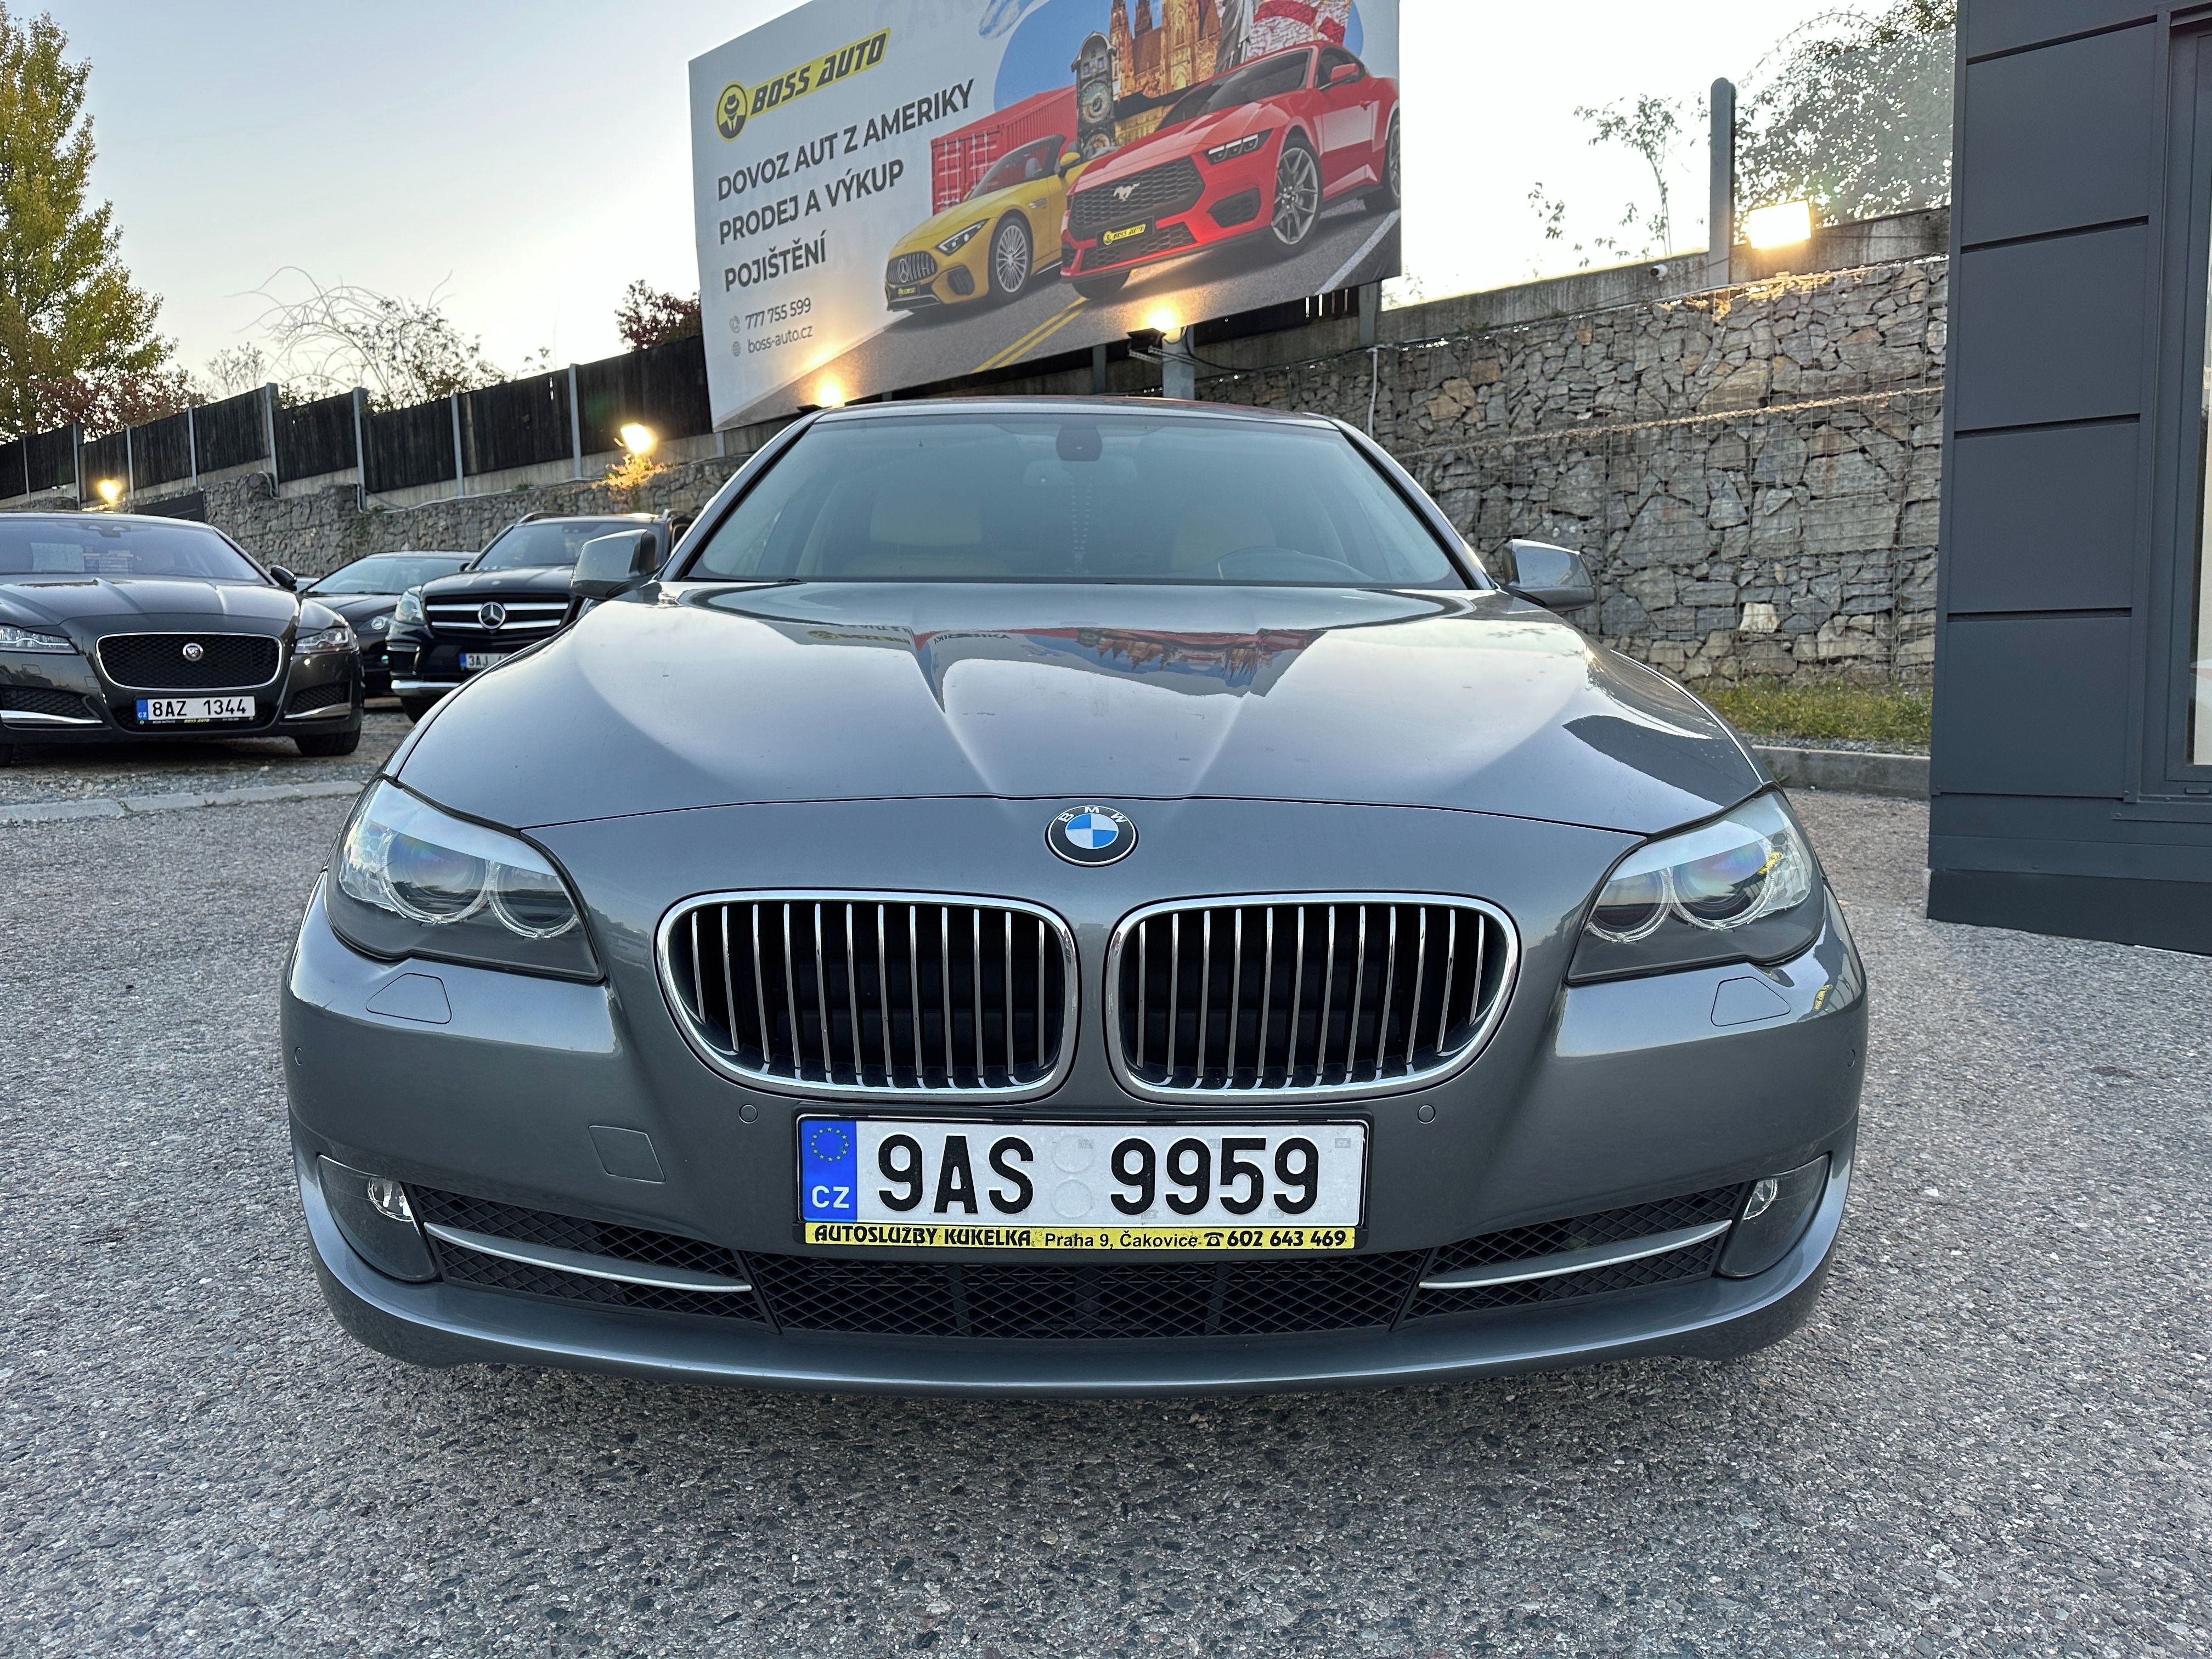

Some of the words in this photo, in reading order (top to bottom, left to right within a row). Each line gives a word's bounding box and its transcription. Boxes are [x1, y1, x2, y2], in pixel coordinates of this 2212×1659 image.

[751, 65, 811, 116] BOSS
[815, 32, 887, 88] AUTO
[718, 151, 789, 201] DOVOZ
[794, 132, 839, 173] AUT
[843, 125, 858, 154] Z
[863, 78, 975, 148] AMERIKY
[719, 195, 799, 245] PRODEJ
[804, 189, 821, 217] A
[825, 159, 905, 208] VÝKUP
[725, 229, 827, 292] POJIŠTĚNÍ
[745, 311, 765, 330] 777
[767, 304, 788, 323] 755
[790, 297, 811, 317] 599
[747, 326, 813, 353] boss-auto.cz
[153, 701, 187, 717] 8AZ
[203, 699, 246, 715] 1344
[1058, 806, 1127, 823] BMW
[811, 1186, 850, 1209] CZ
[878, 1133, 1034, 1215] 9AS
[1110, 1137, 1319, 1215] 9959
[815, 1226, 938, 1245] AUTOSLUŽBY
[944, 1229, 1031, 1246] KUKELKA
[1045, 1233, 1094, 1246] Praha
[1120, 1230, 1199, 1248] Čakovice
[1227, 1231, 1263, 1247] 602
[1269, 1231, 1304, 1247] 643
[1310, 1231, 1347, 1246] 469
